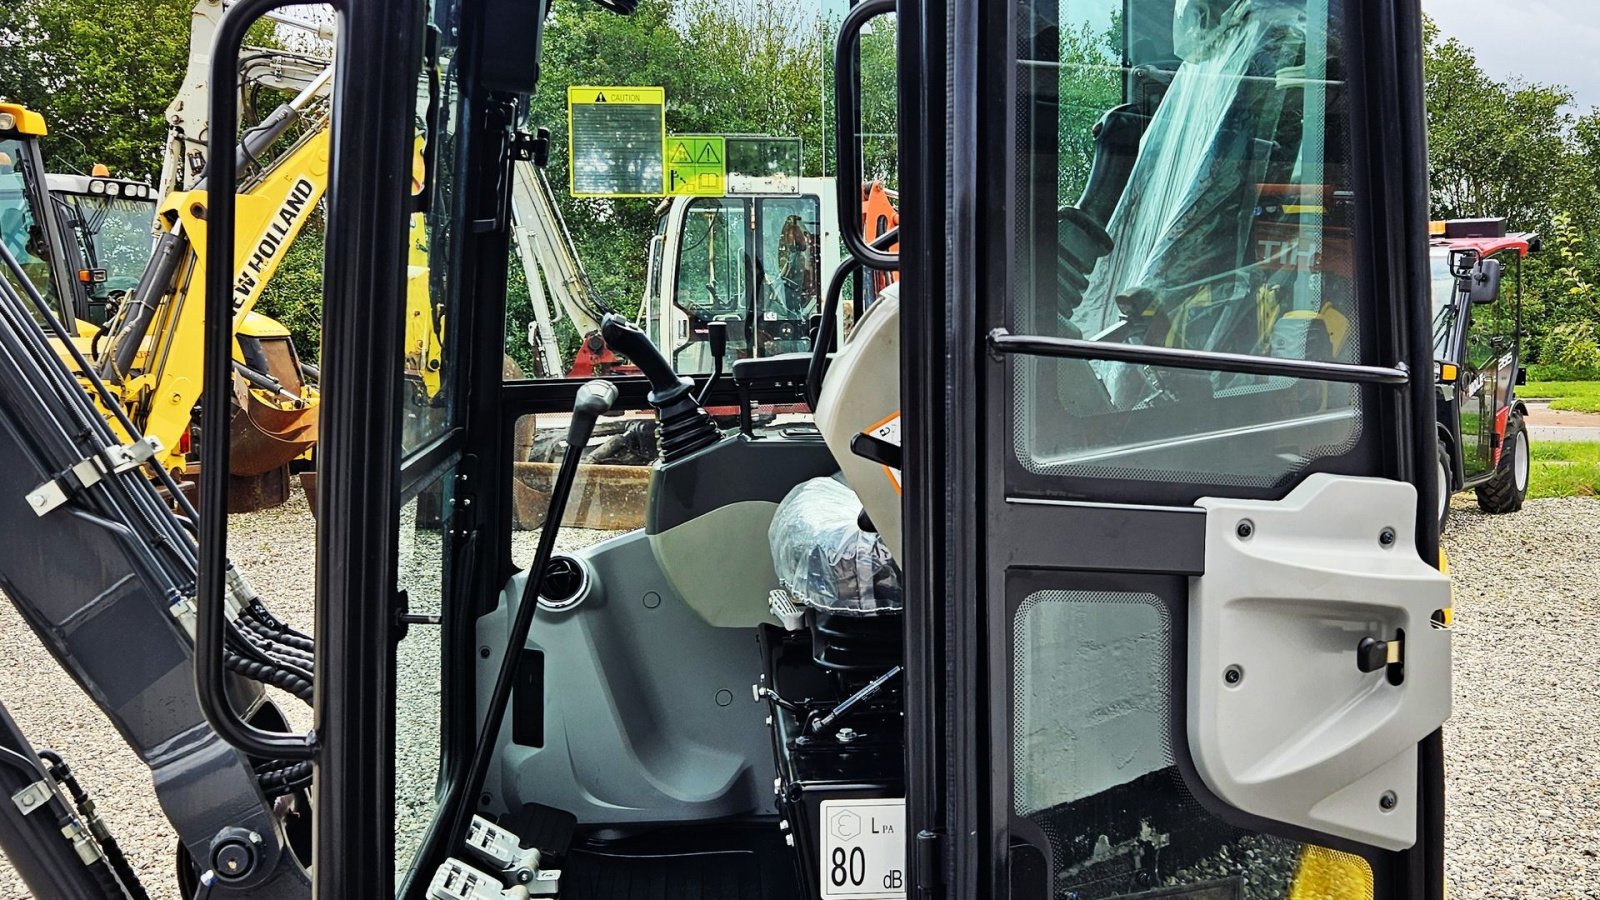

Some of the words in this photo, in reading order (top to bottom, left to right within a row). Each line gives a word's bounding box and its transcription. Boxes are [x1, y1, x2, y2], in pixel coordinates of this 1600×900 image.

[610, 94, 641, 102] CAUTION
[231, 270, 256, 317] EW
[250, 178, 313, 274] HOLLAND
[830, 846, 866, 888] 80
[883, 869, 903, 889] dB
